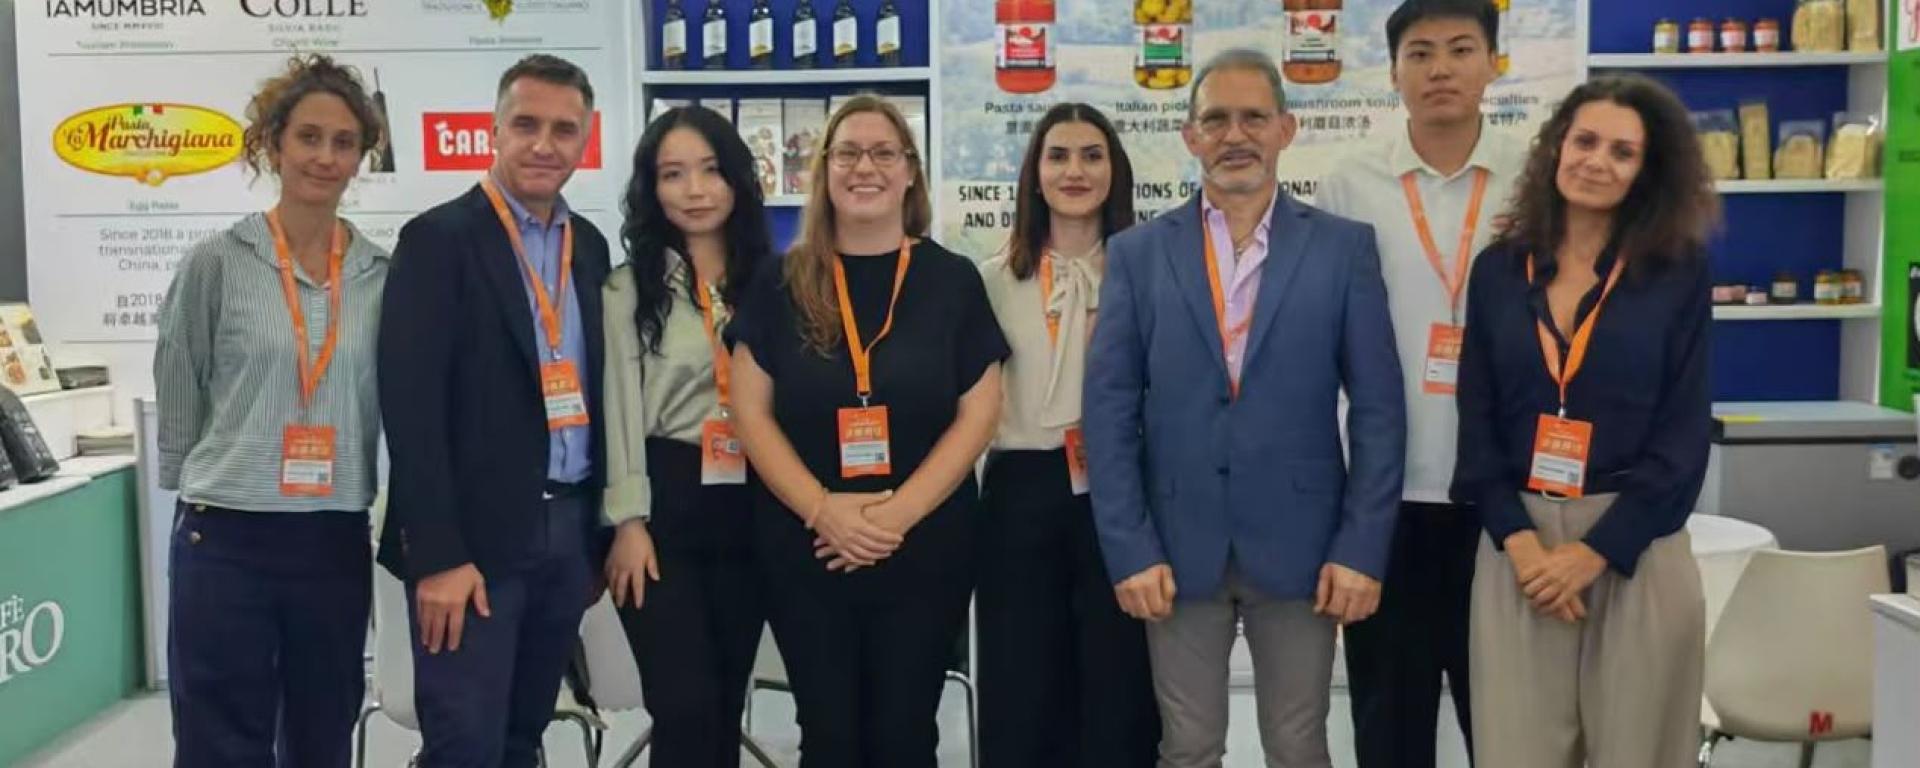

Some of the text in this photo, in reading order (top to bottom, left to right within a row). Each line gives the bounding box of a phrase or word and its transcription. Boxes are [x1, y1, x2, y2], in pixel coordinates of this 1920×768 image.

[240, 0, 368, 18] COLLE
[985, 102, 1051, 113] Pasta sau
[1115, 100, 1189, 114] Italian pick
[107, 114, 149, 131] Pasta
[85, 119, 234, 157] Marchigiana
[438, 128, 497, 157] CAR
[959, 185, 1000, 201] SINCE
[1135, 182, 1172, 199] IONS
[964, 211, 994, 228] AND
[100, 228, 139, 241] Since
[0, 600, 64, 684] RO
[1810, 710, 1833, 735] M
